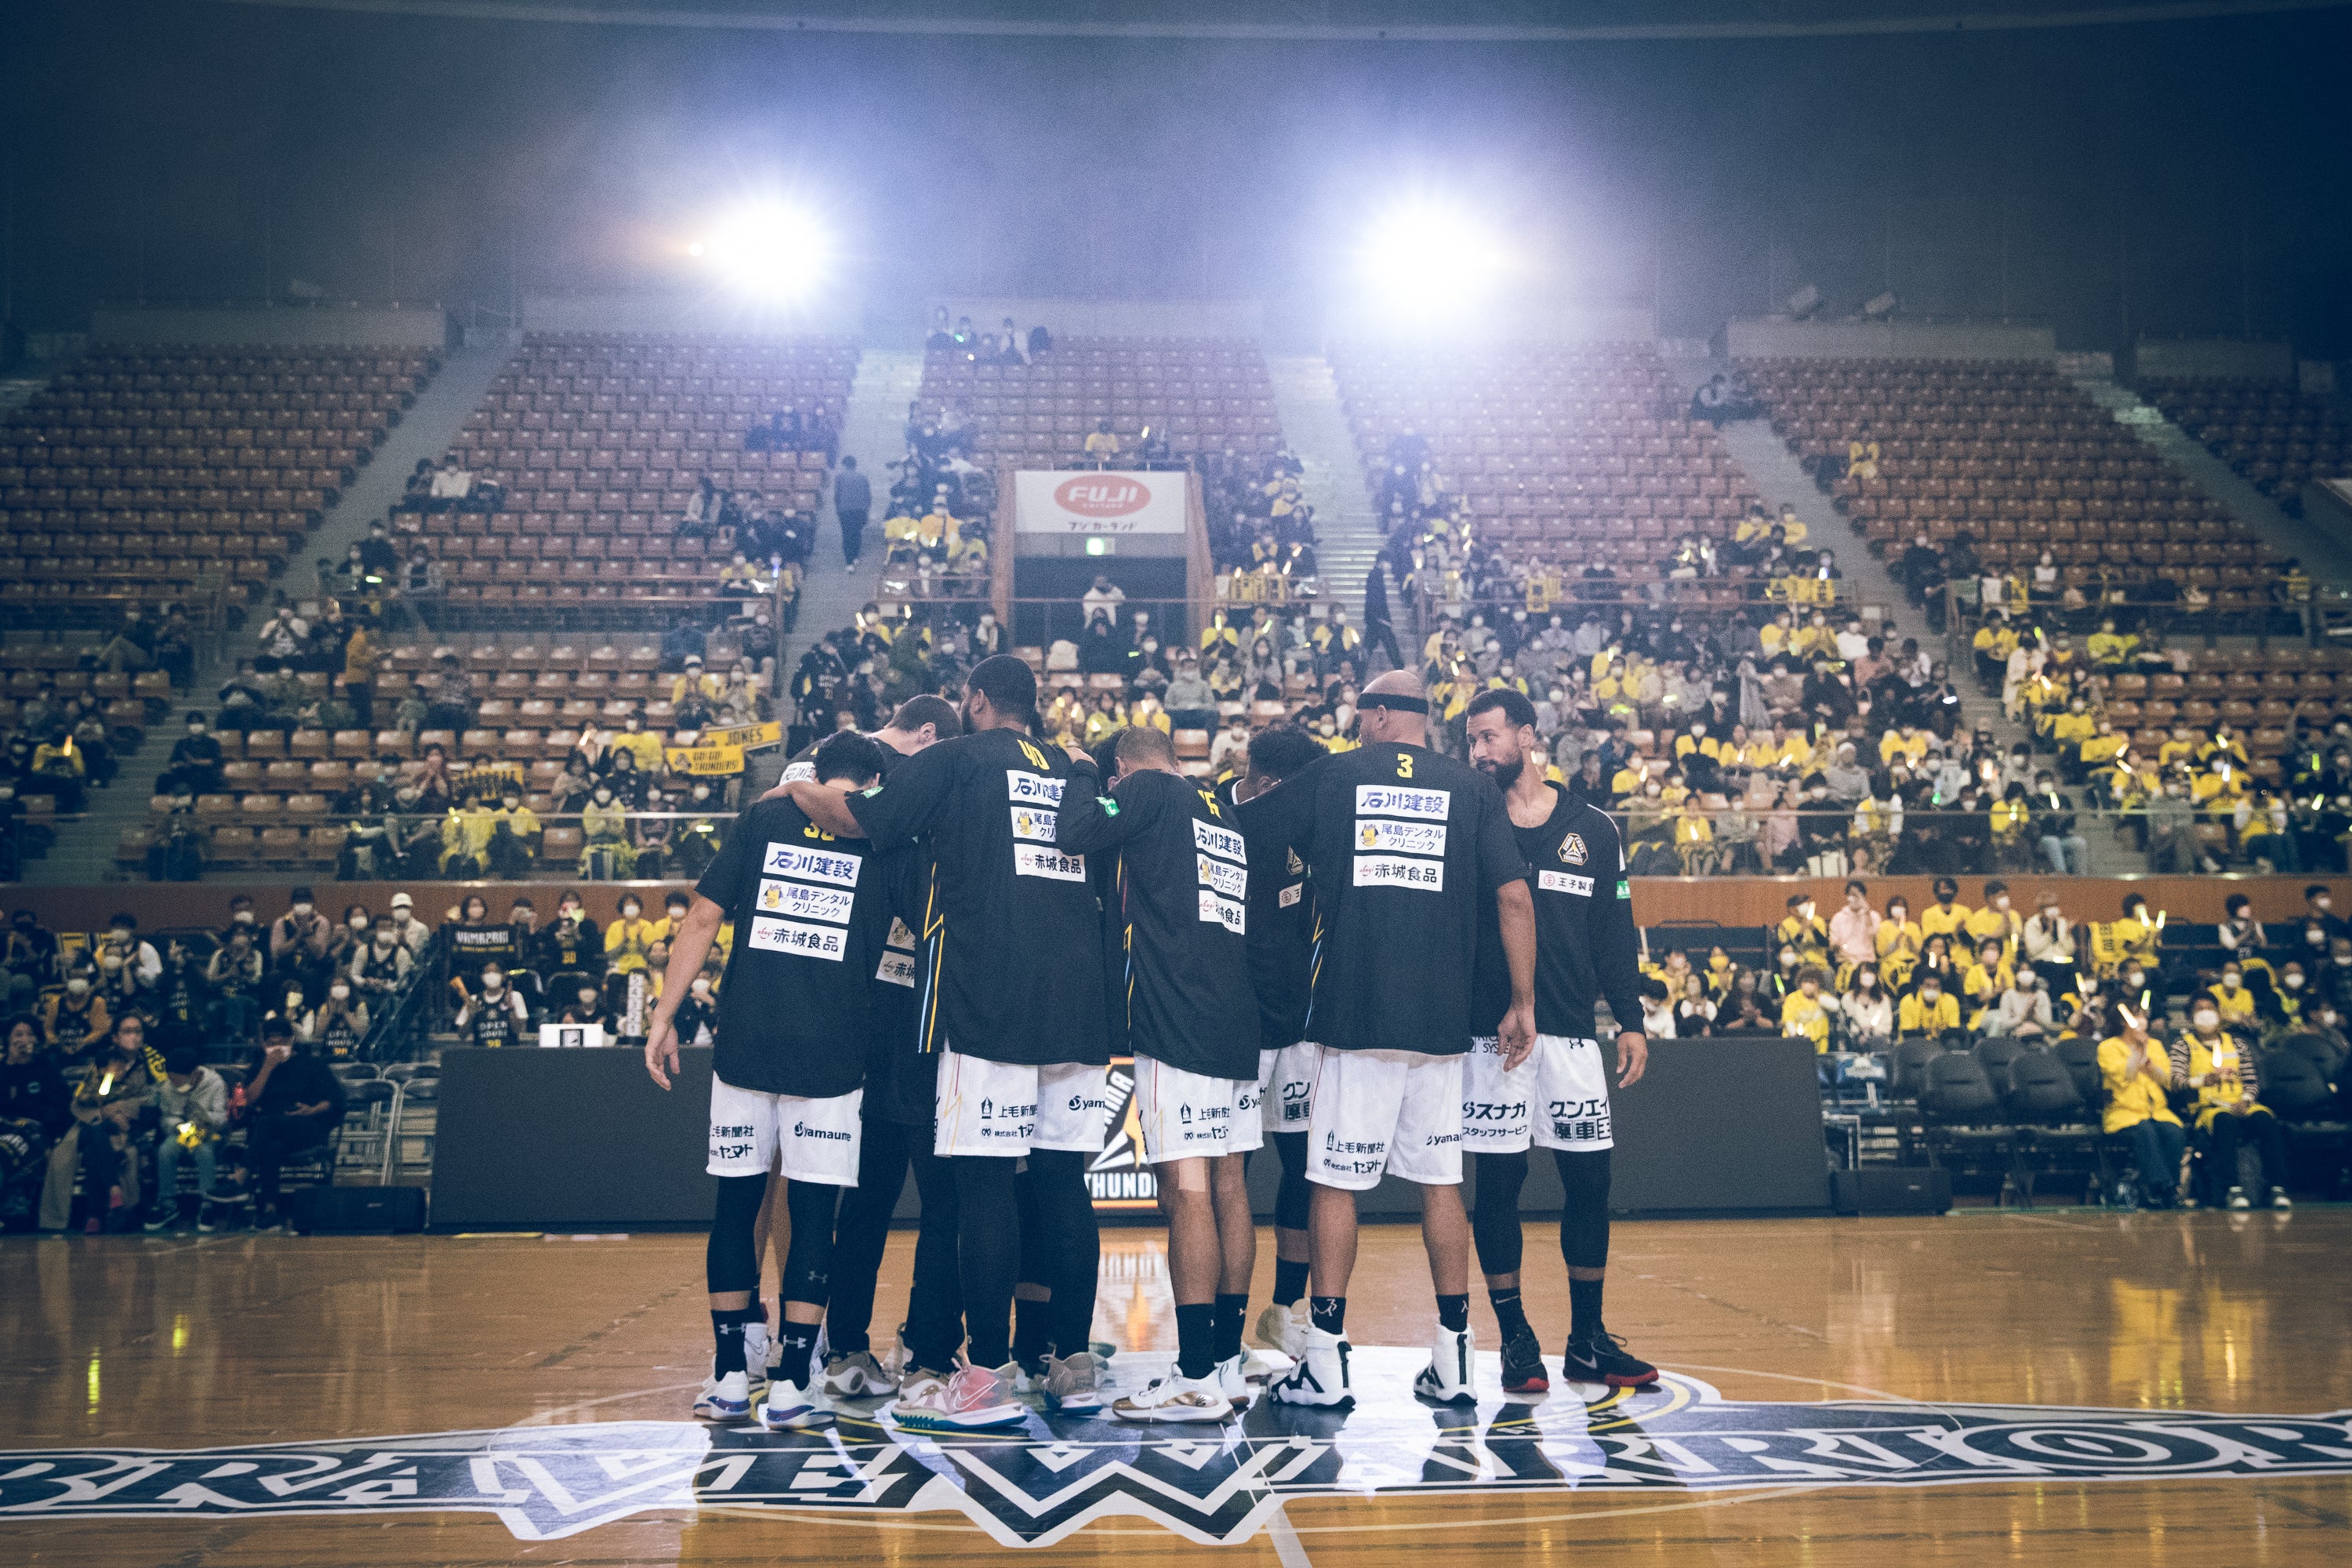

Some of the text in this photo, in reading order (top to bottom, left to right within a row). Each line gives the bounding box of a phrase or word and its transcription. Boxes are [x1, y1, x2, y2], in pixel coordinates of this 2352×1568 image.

[1069, 486, 1137, 503] FUJI
[726, 728, 763, 746] JONES
[1017, 739, 1050, 770] 40
[1397, 753, 1413, 778] 3
[1014, 778, 1066, 802] 石川建
[1361, 792, 1444, 814] 石川建設
[1381, 824, 1443, 839] 尾島デンタル
[1196, 827, 1243, 858] 石川建設
[1388, 837, 1436, 850] クリニック
[770, 851, 855, 880] 石川建設
[1035, 854, 1082, 874] 赤城食品
[1375, 863, 1437, 883] 赤城食品
[1213, 877, 1242, 893] クリニック
[787, 887, 851, 906] 尾島デンタル
[792, 902, 840, 917] クリニック
[774, 928, 839, 952] 赤城食品
[1476, 1101, 1526, 1120] スナガ
[1549, 1096, 1608, 1119] グンエイ
[804, 1126, 851, 1142] yamaune
[1335, 1140, 1385, 1154] 上毛新聞社
